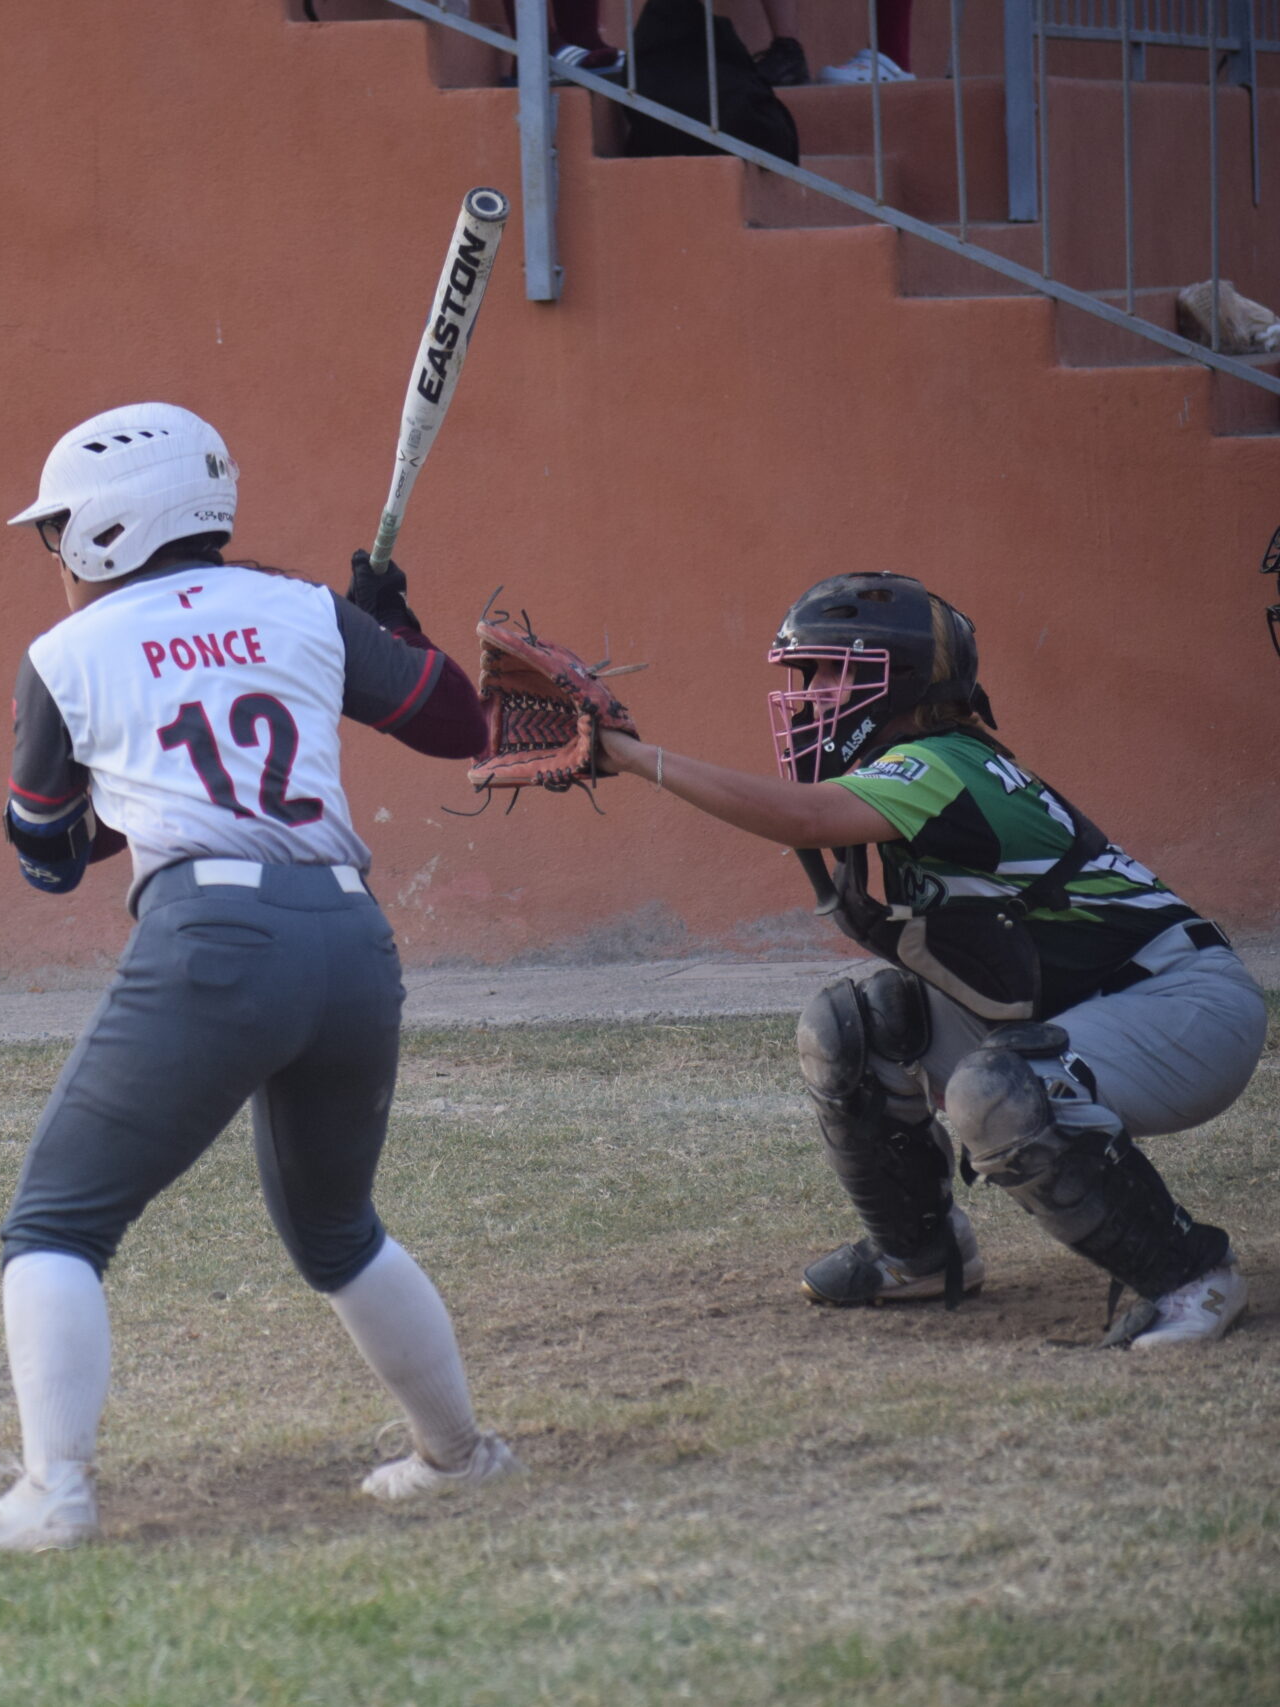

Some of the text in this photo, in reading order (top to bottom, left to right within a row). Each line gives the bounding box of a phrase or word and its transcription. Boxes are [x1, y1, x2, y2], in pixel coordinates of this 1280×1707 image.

[417, 227, 487, 405] EASTON
[142, 627, 266, 678] PONCE
[157, 692, 324, 828] 12
